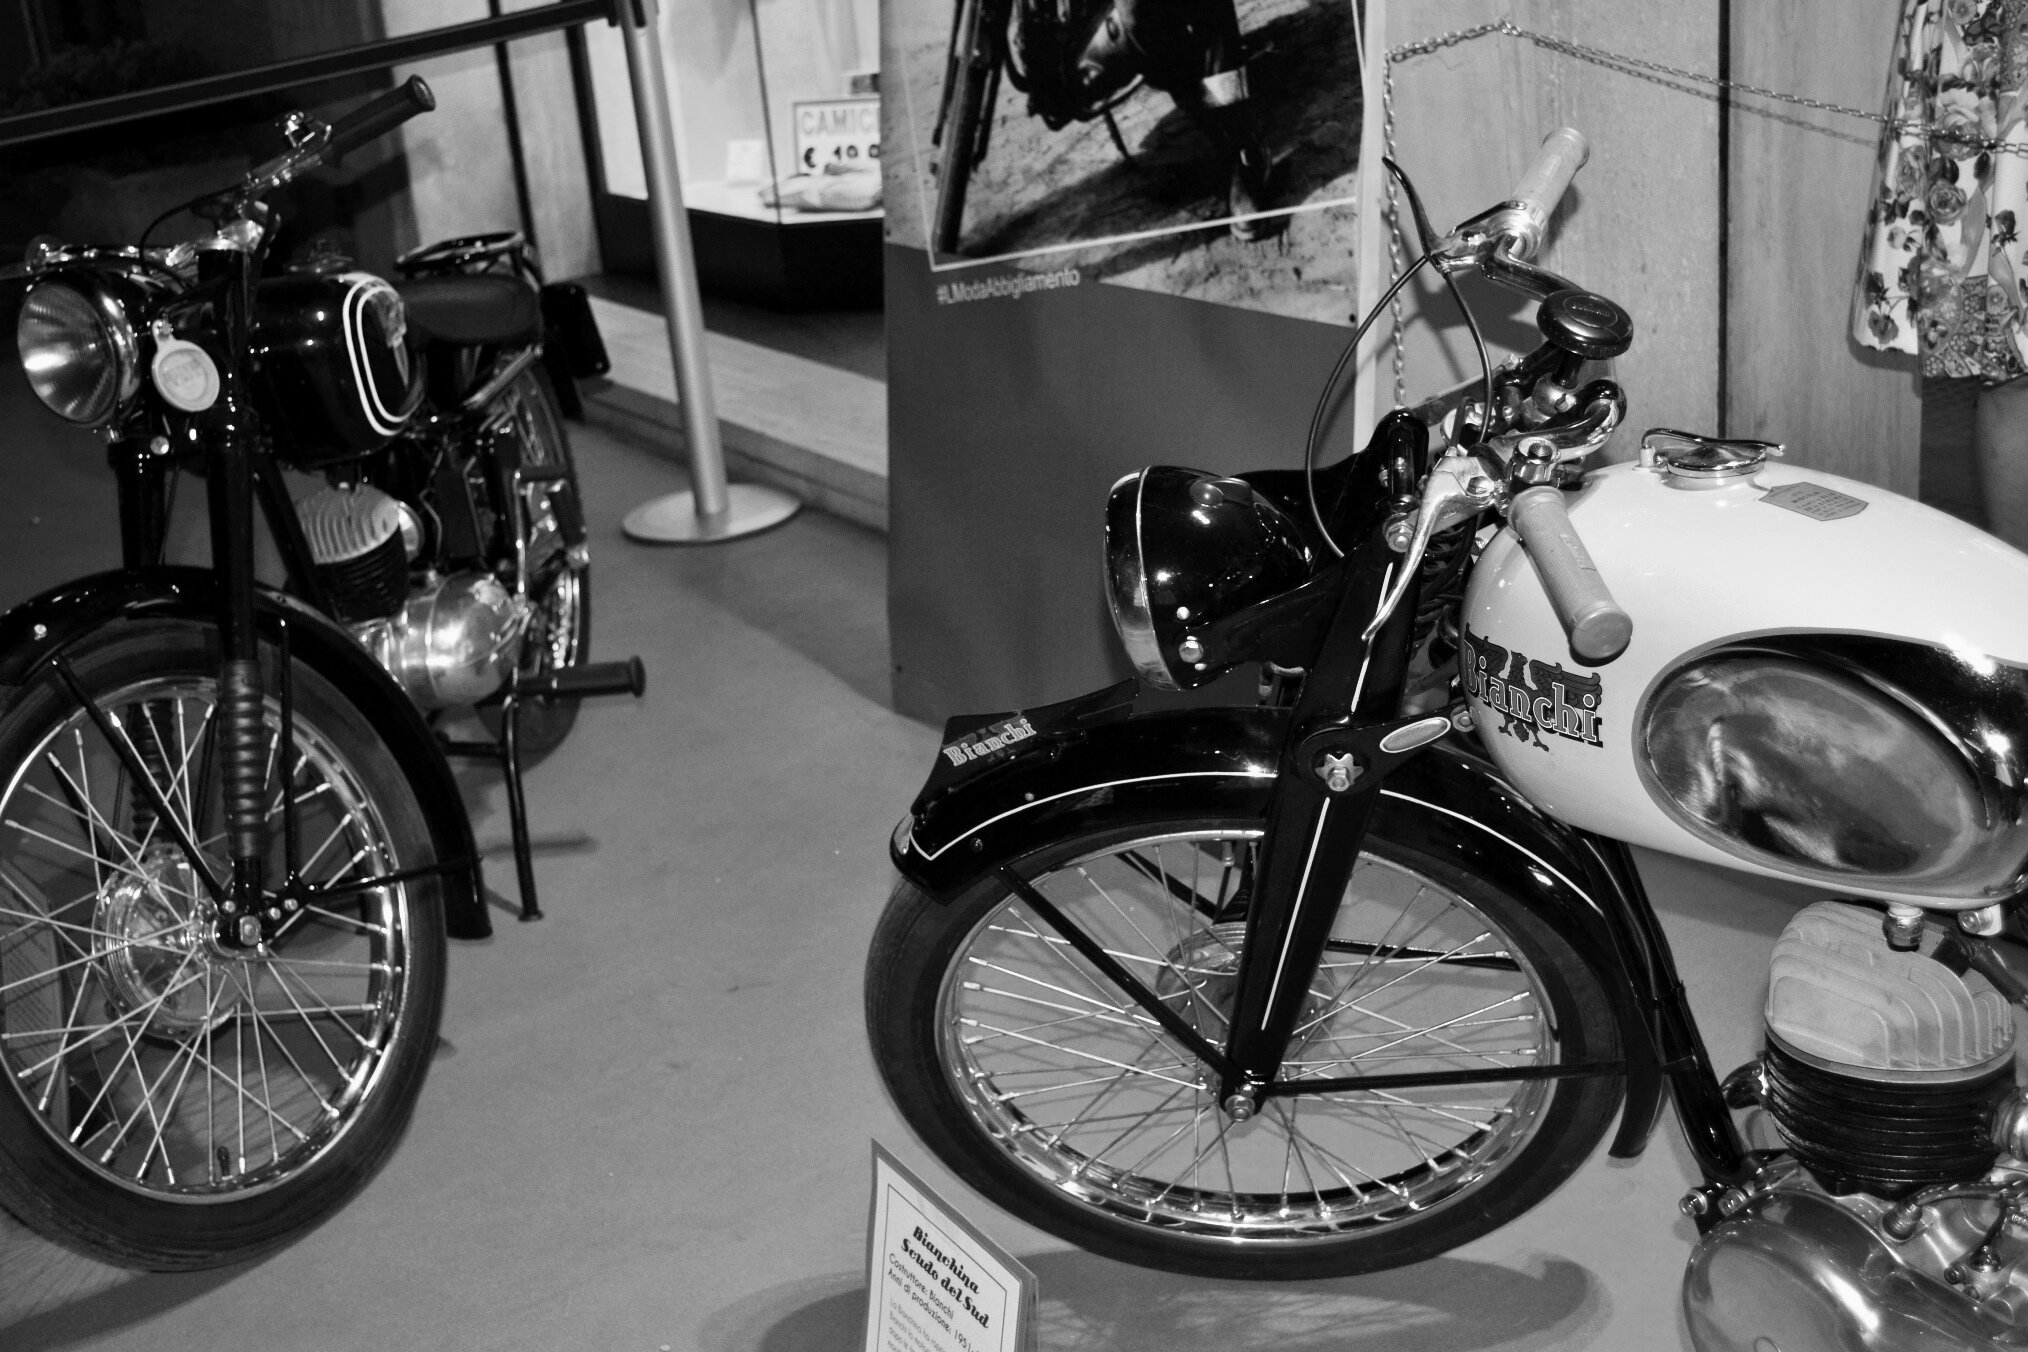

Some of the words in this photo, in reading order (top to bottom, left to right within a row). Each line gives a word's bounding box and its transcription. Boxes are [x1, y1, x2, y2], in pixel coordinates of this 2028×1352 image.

[1463, 638, 1602, 746] Bianchi
[943, 718, 1037, 767] Bianchi
[888, 1253, 929, 1295] Costruttore:
[929, 1289, 954, 1320] Bianchi
[901, 1238, 939, 1281] Scudo
[940, 1277, 963, 1303] del
[962, 1296, 990, 1329] Sud
[912, 1225, 980, 1295] Bianchina
[887, 1268, 903, 1287] Anni
[903, 1283, 911, 1295] di
[911, 1292, 952, 1334] produzione:
